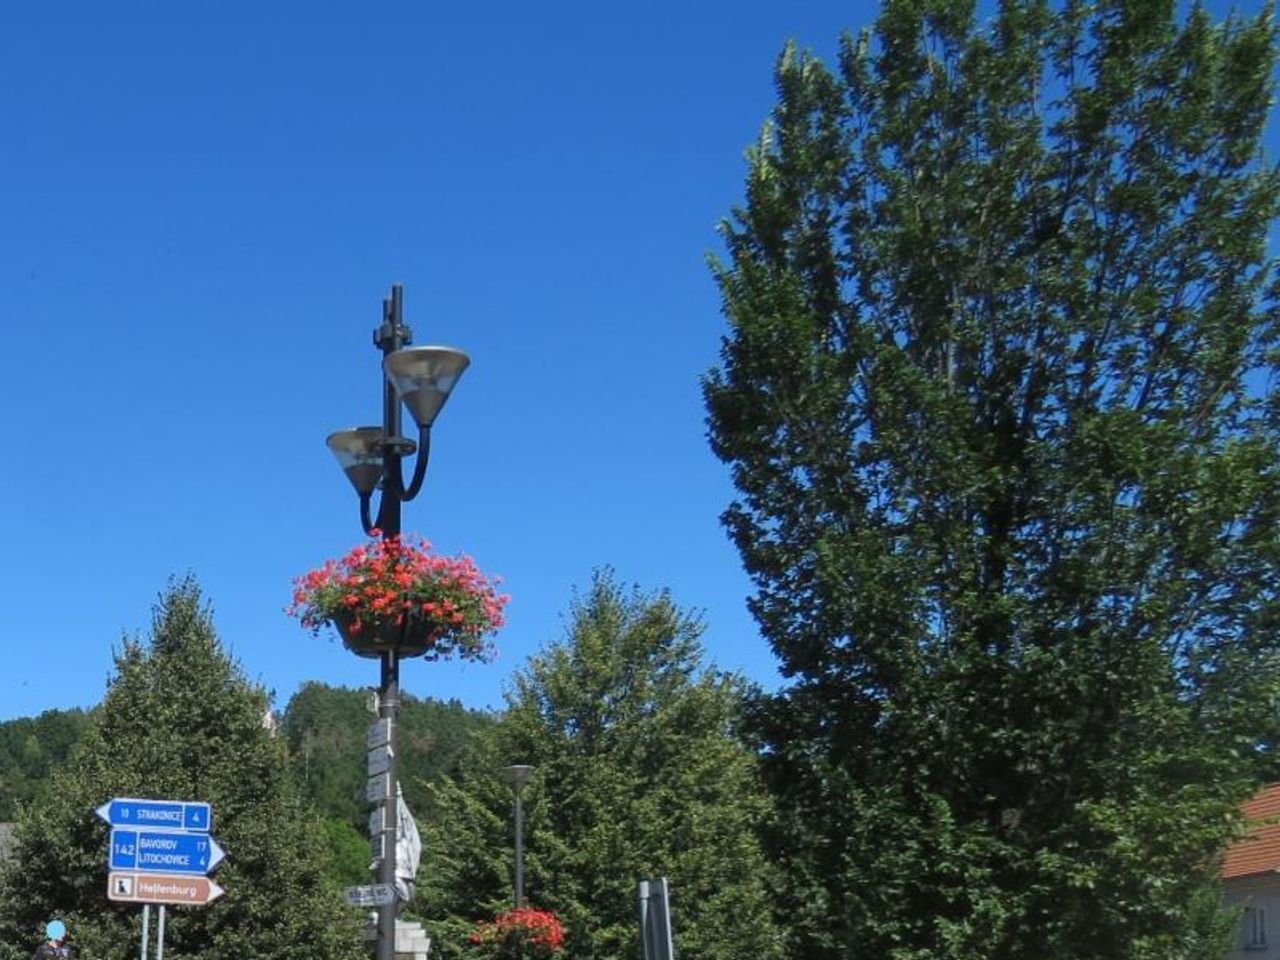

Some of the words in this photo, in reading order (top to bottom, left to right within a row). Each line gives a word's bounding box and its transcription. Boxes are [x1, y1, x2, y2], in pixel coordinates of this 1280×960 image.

[137, 809, 182, 820] STRAKONICE
[191, 812, 200, 822] 4
[114, 843, 135, 856] 142
[141, 839, 177, 850] BAVOROV
[140, 854, 190, 865] LITOCHOVICE
[140, 883, 196, 897] Helfenburg
